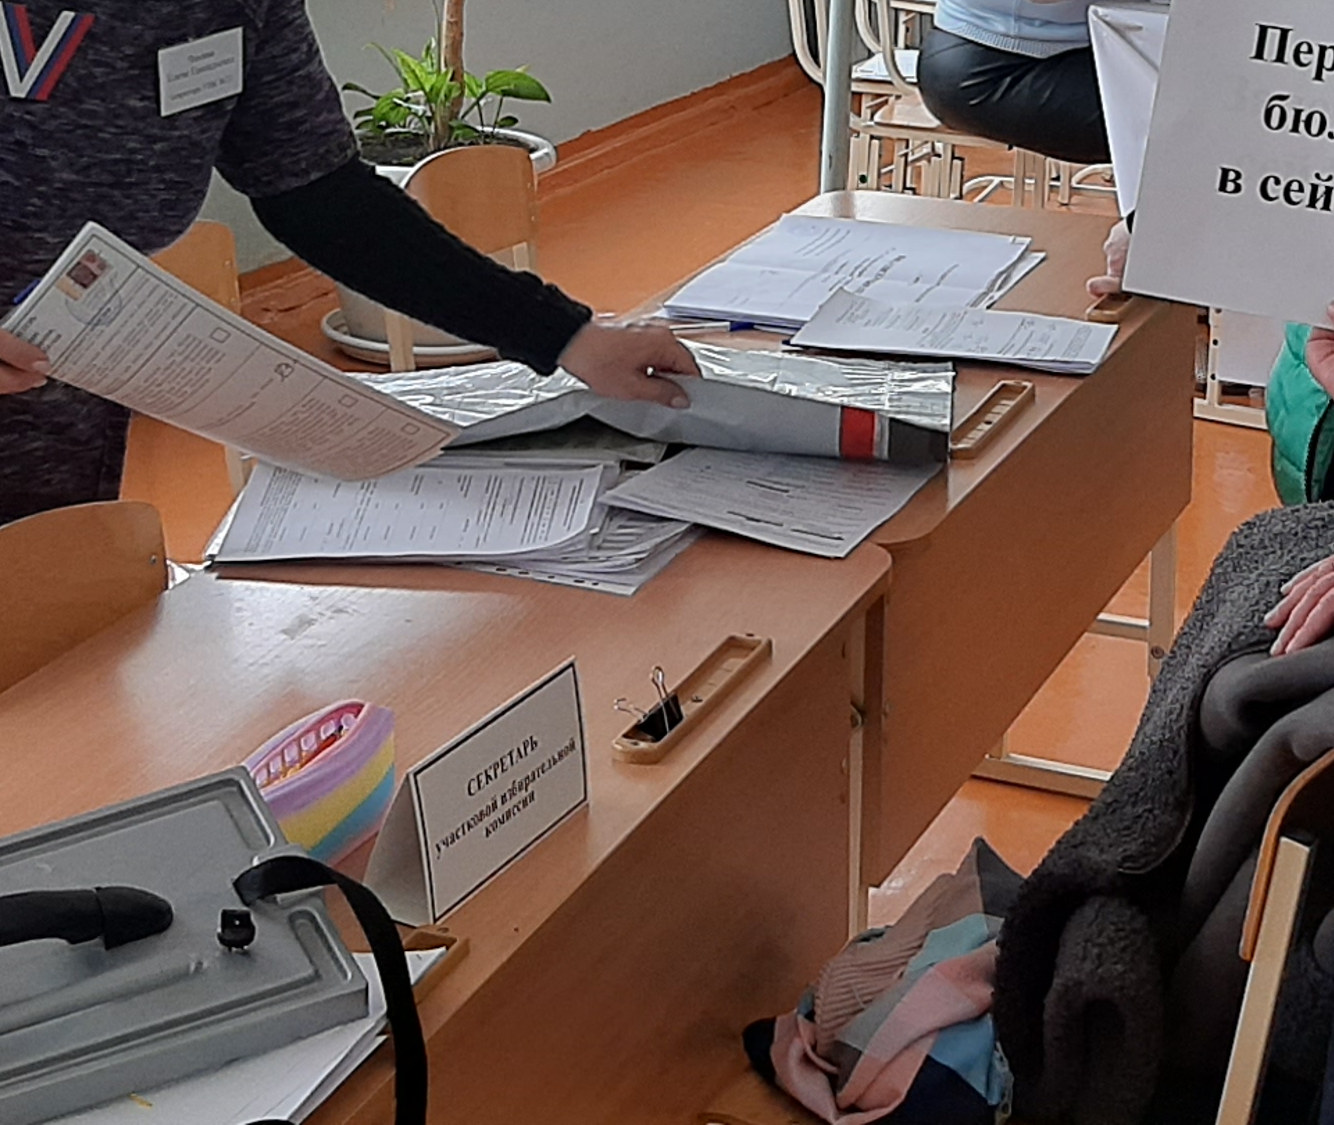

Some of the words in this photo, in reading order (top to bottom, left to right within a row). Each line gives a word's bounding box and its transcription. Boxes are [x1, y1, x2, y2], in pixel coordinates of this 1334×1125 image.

[1217, 166, 1243, 195] в
[467, 735, 538, 797] СЕКРЕТАРЬ
[435, 795, 498, 860] участковой
[500, 737, 576, 807] избирательной
[485, 790, 535, 839] комиссии
